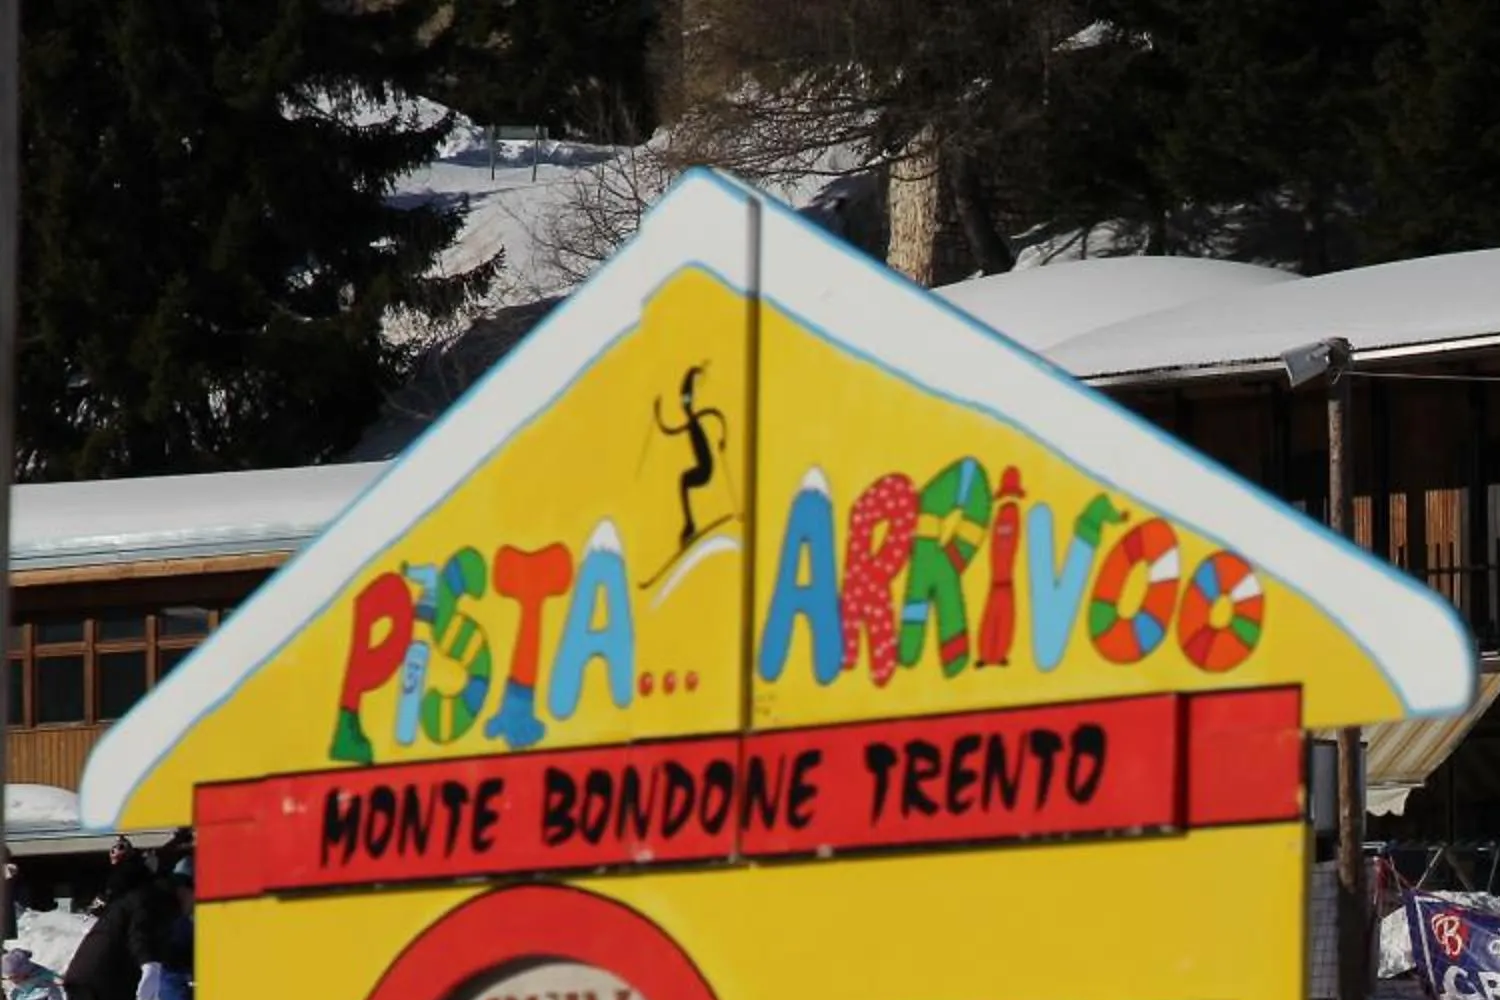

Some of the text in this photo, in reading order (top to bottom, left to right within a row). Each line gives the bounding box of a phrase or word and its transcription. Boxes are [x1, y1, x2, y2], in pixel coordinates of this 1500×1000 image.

[320, 723, 1107, 868] MONTE BONDONE TRENTO
